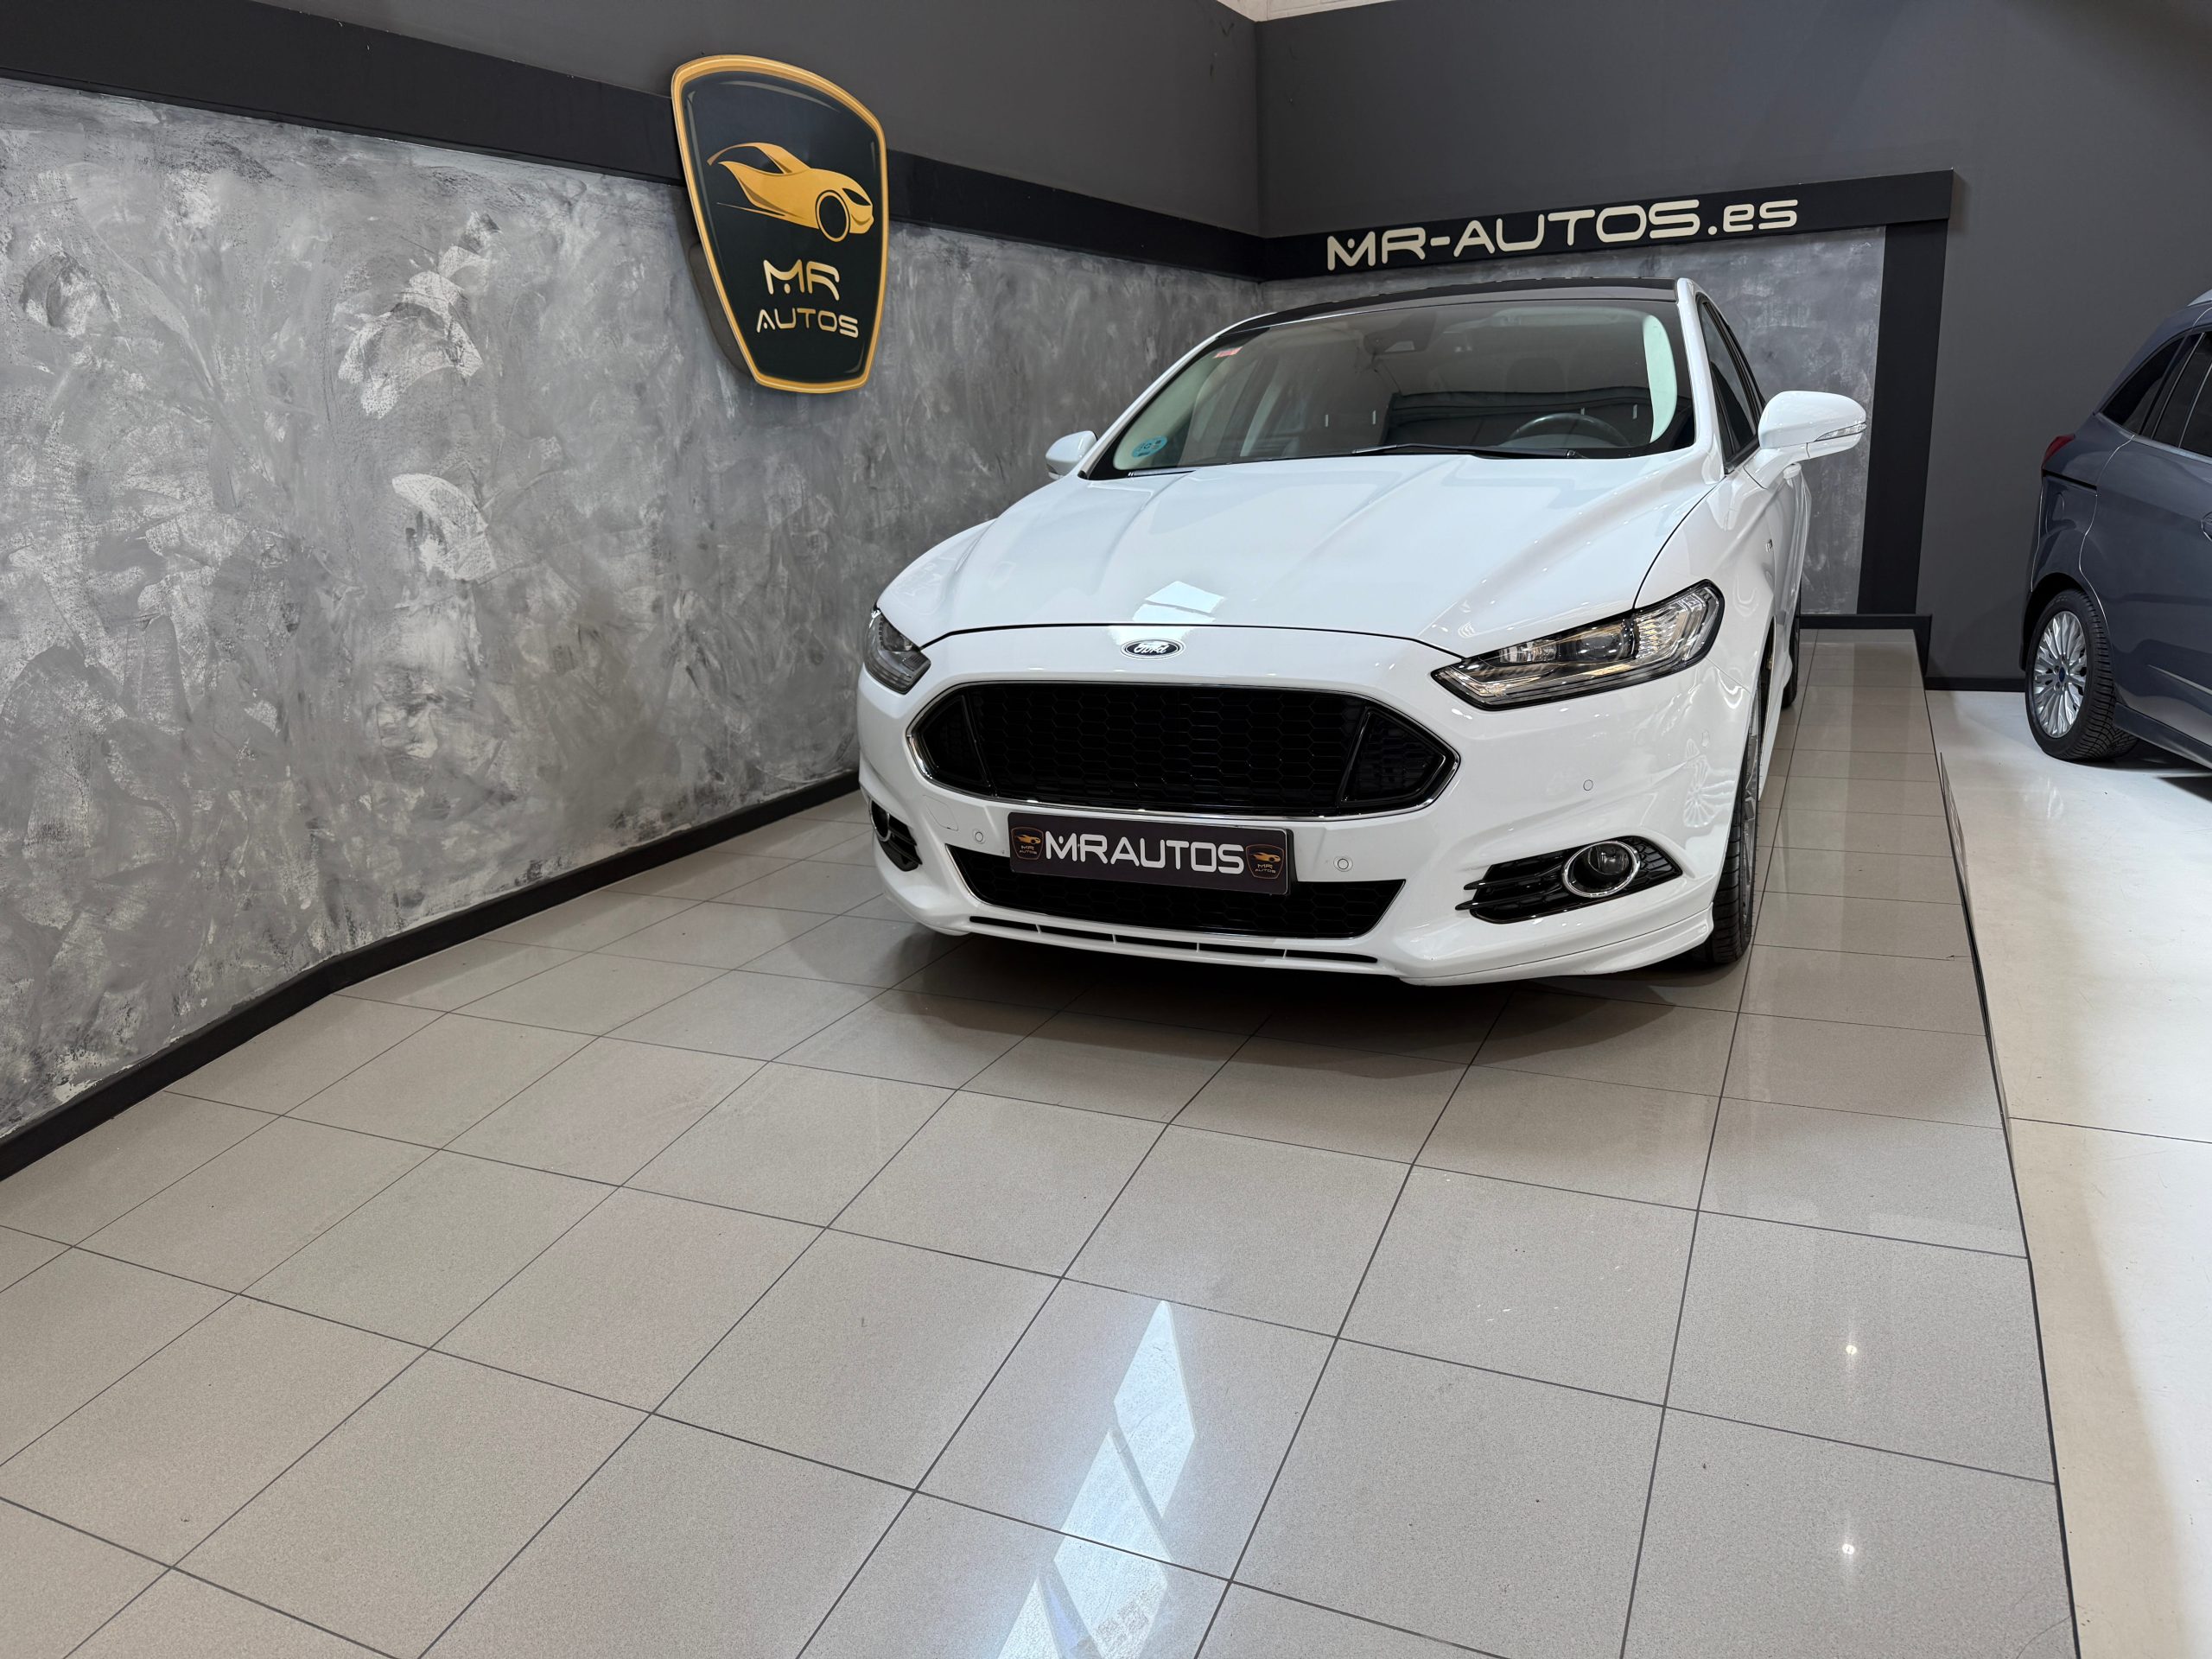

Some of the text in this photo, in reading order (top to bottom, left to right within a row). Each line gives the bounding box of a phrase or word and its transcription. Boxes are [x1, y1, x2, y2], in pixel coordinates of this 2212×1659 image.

[1327, 200, 1798, 271] MR-AUTOS.es
[763, 259, 840, 301] MR
[756, 308, 859, 338] AUTOS
[1134, 640, 1169, 654] Ford
[1045, 830, 1245, 874] MRAUTOS
